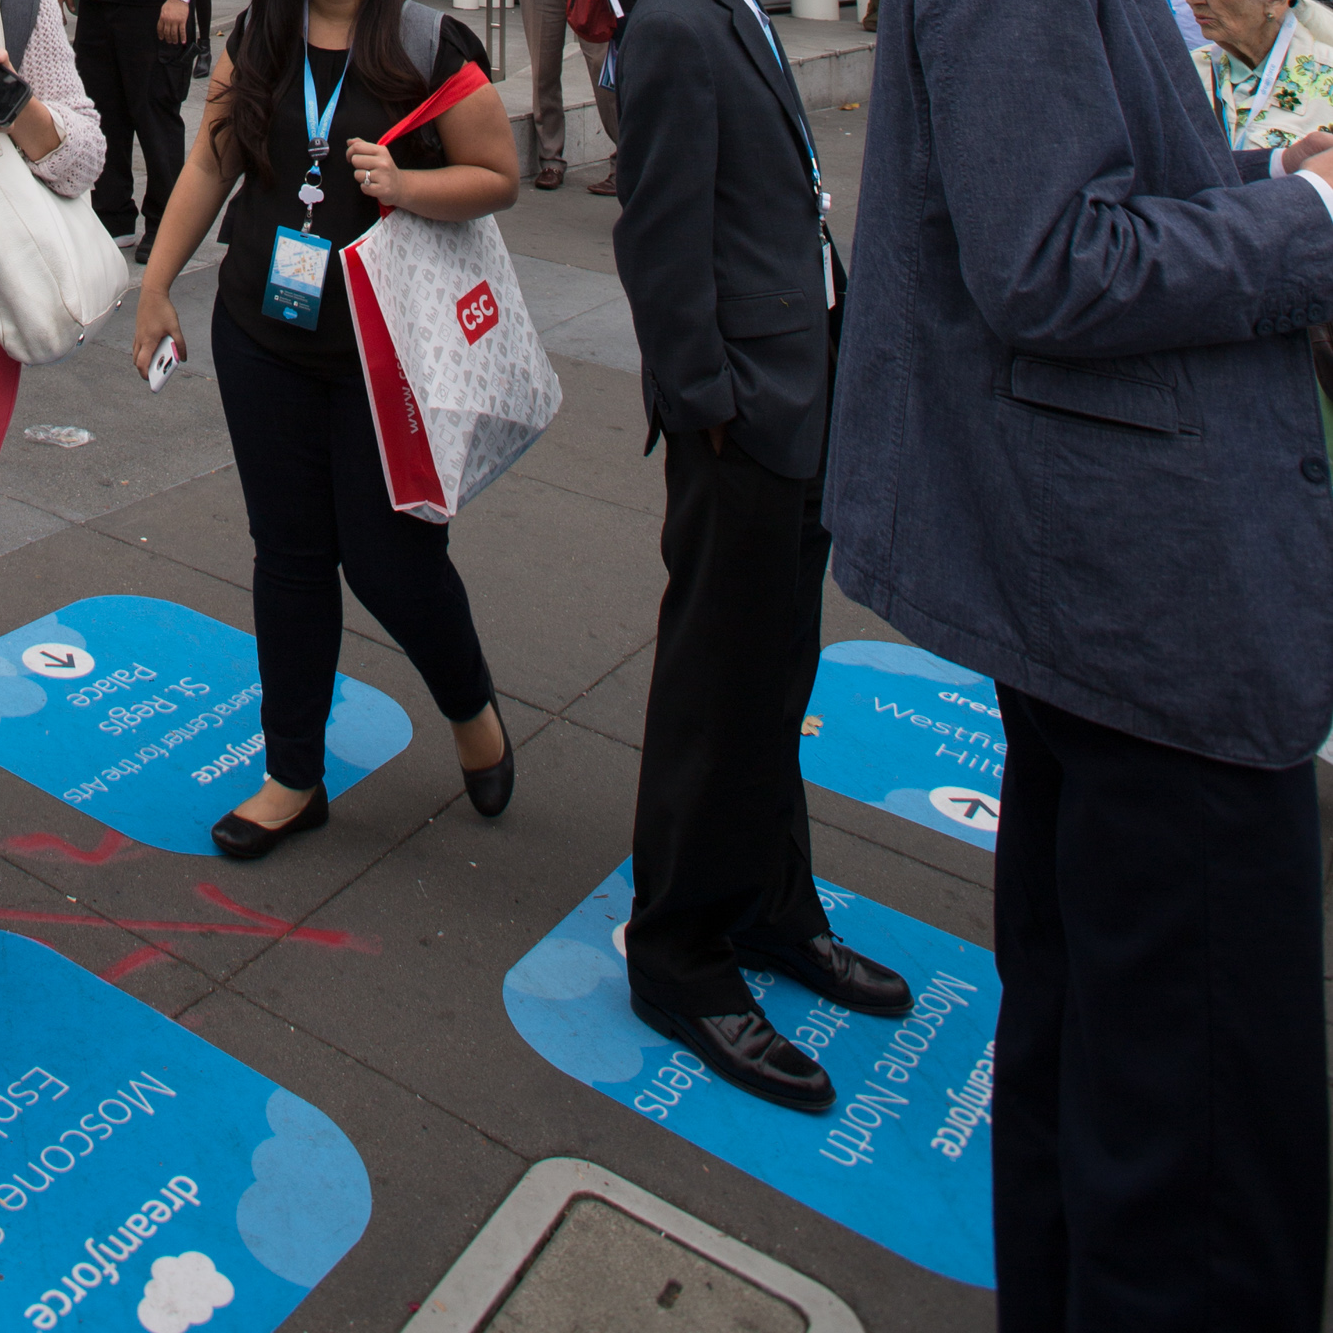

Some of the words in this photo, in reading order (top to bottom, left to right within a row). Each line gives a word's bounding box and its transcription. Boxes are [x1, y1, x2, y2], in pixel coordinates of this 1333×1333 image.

[462, 294, 494, 331] CSC
[66, 662, 158, 707] Palace
[164, 676, 211, 698] St.
[98, 695, 178, 736] Regis
[160, 712, 224, 751] Center
[101, 759, 143, 782] the
[134, 743, 170, 764] for
[63, 775, 109, 804] Arts
[874, 970, 979, 1086] Moscone
[819, 1080, 910, 1168] North
[24, 1175, 202, 1330] dreamforce
